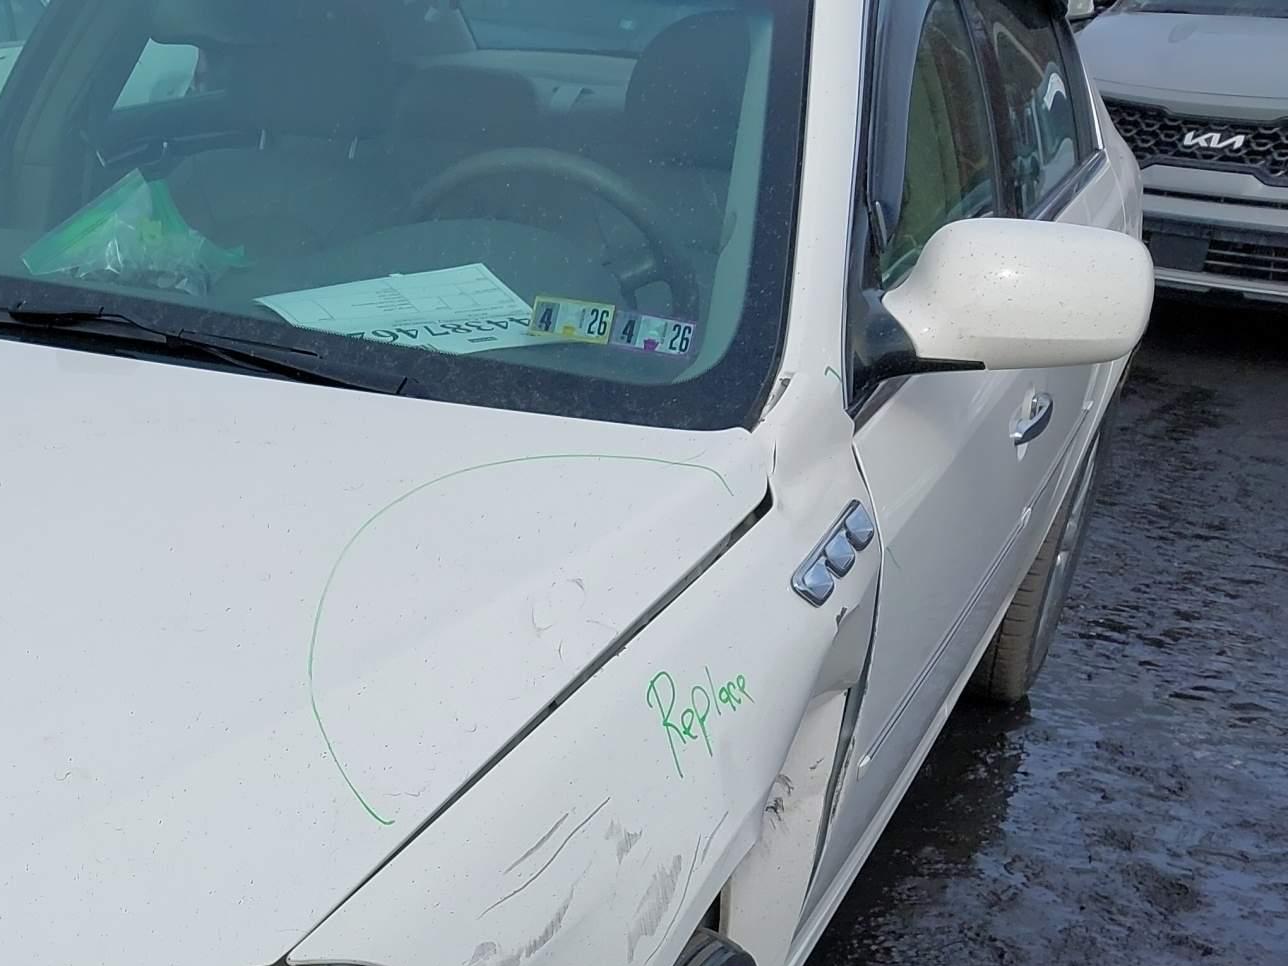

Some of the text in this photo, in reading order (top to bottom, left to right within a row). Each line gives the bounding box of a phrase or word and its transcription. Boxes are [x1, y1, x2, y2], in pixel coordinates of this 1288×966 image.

[1184, 130, 1245, 150] KIA
[587, 308, 610, 336] 26
[621, 319, 636, 344] 4
[668, 324, 692, 353] 26
